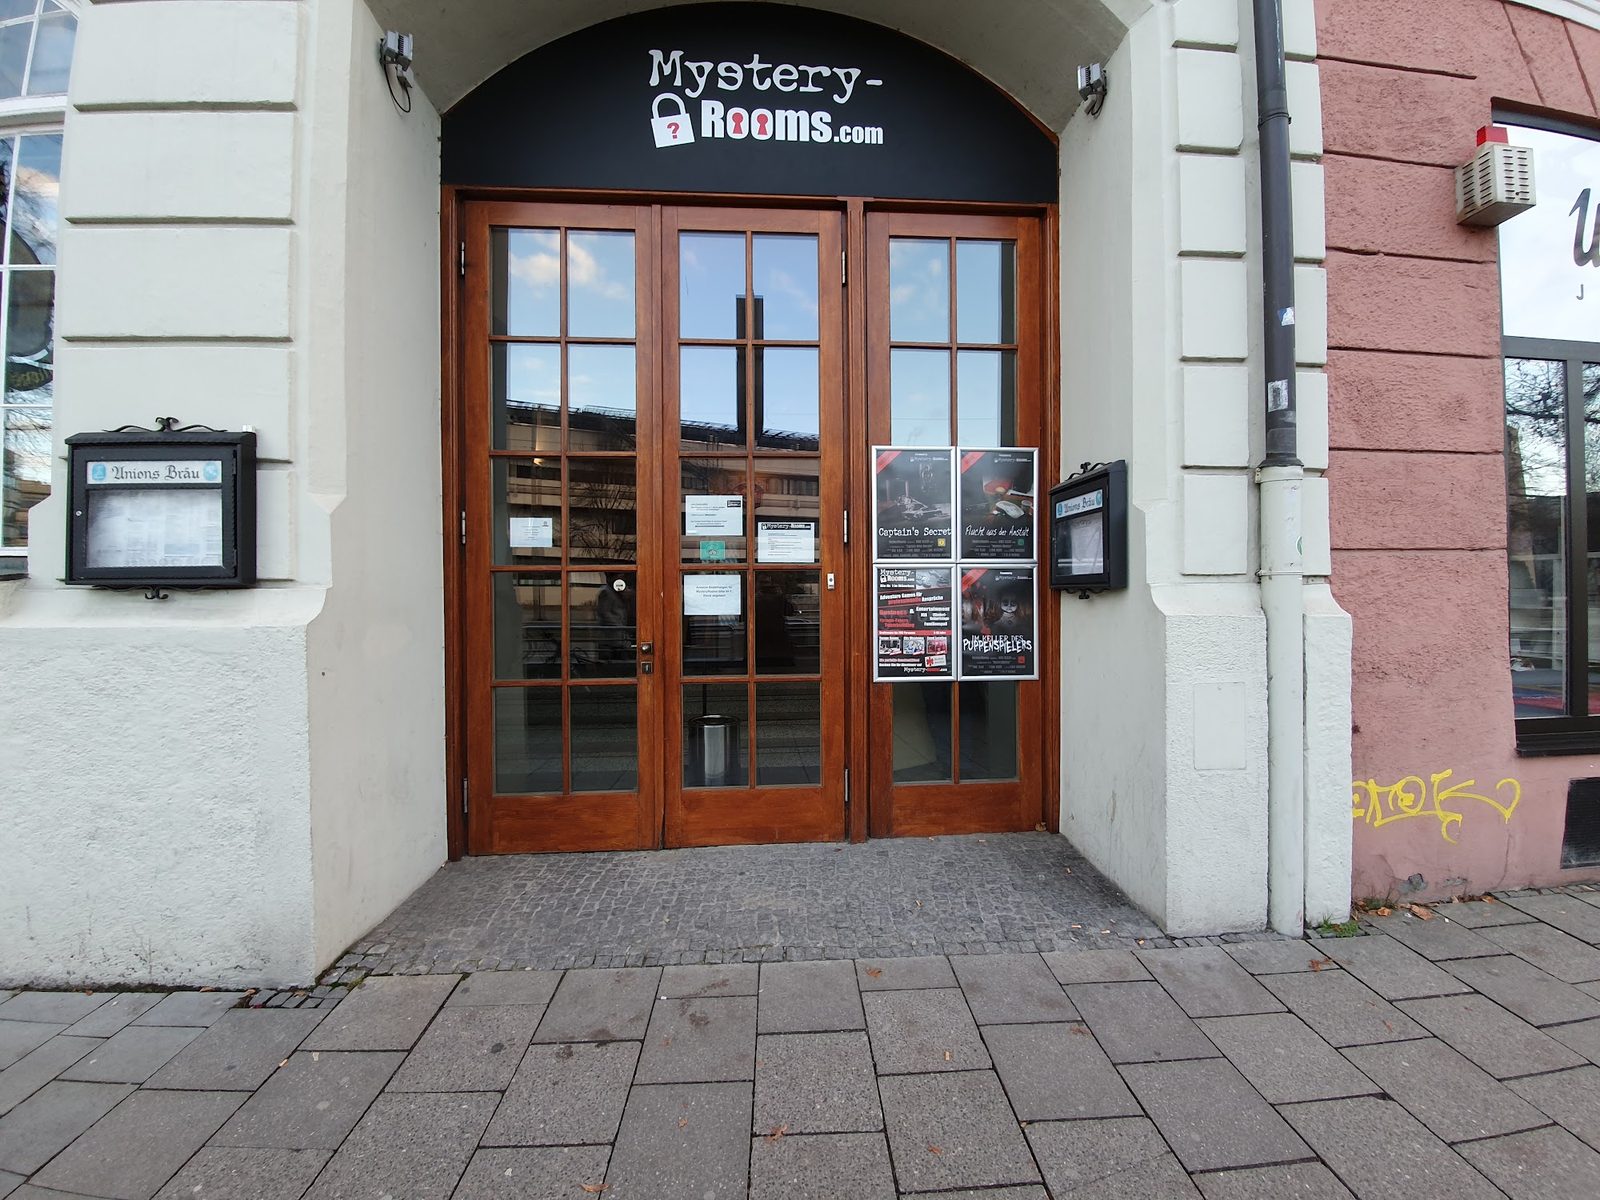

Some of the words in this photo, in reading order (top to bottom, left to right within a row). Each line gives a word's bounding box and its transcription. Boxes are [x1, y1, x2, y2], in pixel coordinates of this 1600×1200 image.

[649, 49, 883, 104] Mystery-
[701, 100, 884, 145] Rooms.com
[112, 466, 160, 480] Unions
[164, 464, 200, 481] Bräu
[878, 527, 920, 538] Captain's
[923, 527, 952, 537] Secret
[962, 638, 1033, 654] PUPPENSPIELERS
